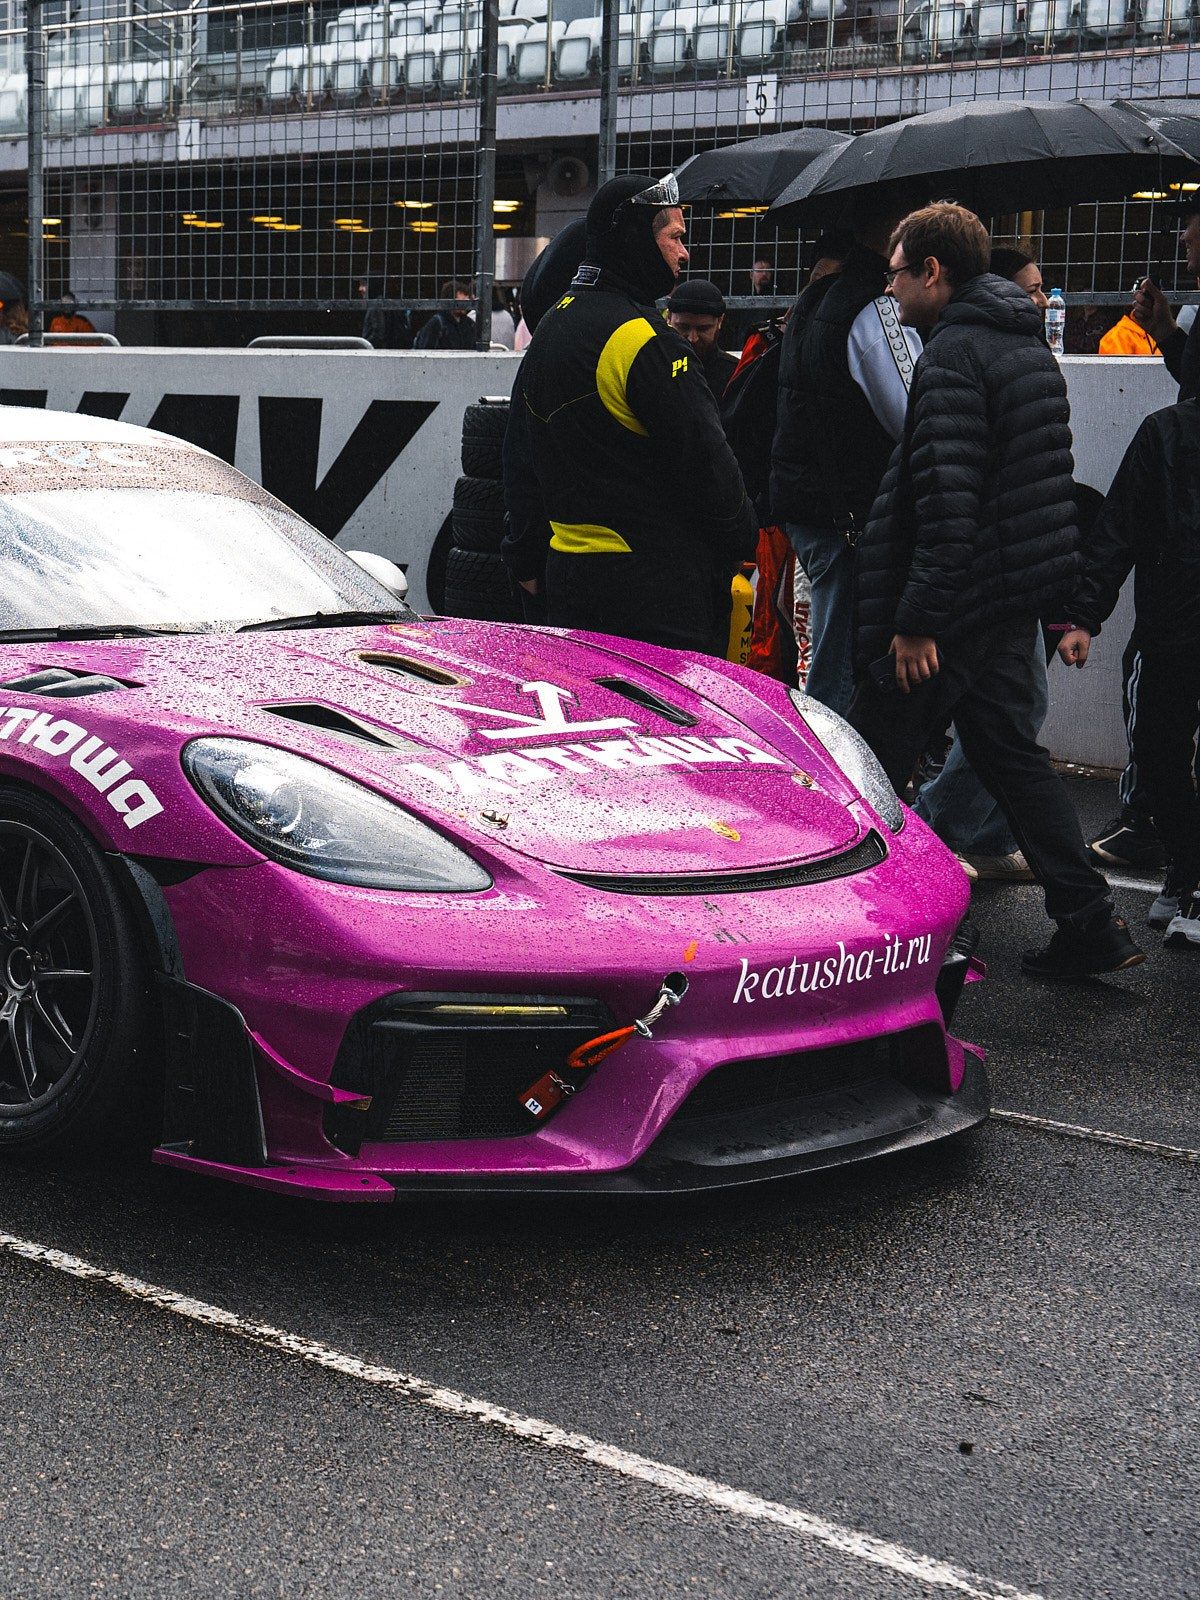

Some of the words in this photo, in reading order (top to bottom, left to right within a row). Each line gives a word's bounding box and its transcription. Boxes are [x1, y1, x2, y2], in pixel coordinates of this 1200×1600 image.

[755, 82, 767, 116] 5
[184, 126, 193, 153] 4
[732, 932, 933, 1004] katusha-it.ru
[528, 1100, 539, 1112] M
